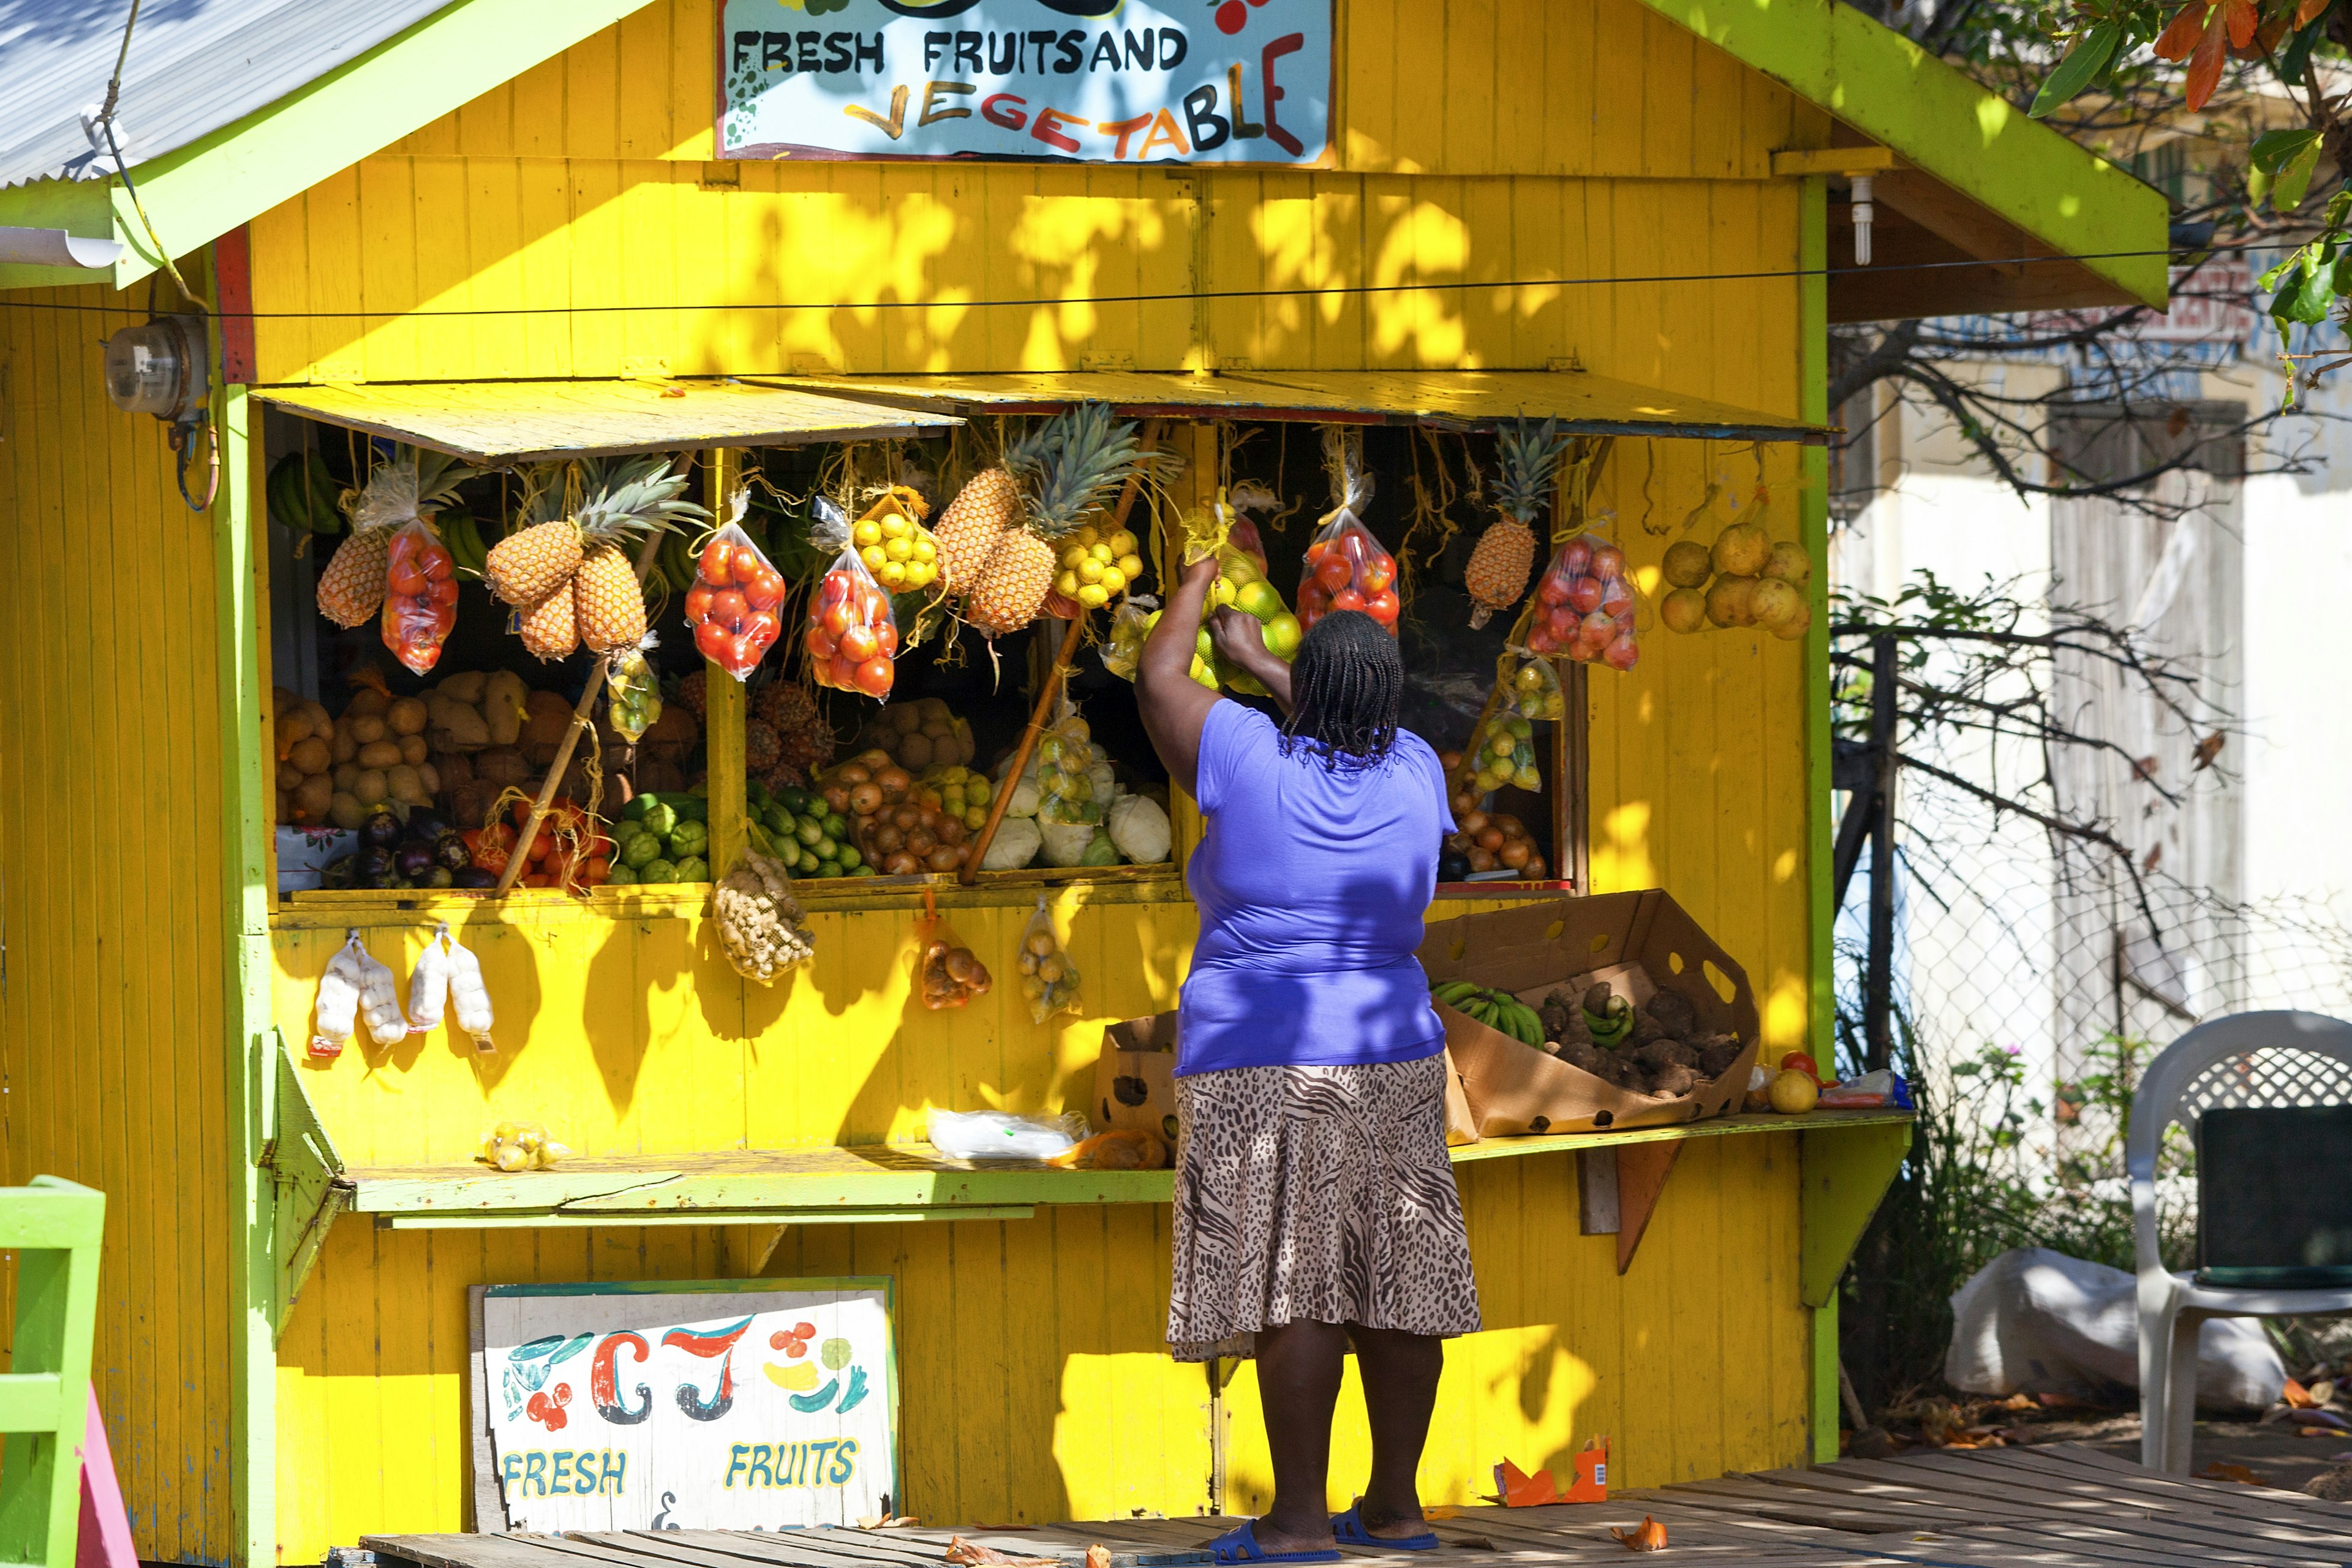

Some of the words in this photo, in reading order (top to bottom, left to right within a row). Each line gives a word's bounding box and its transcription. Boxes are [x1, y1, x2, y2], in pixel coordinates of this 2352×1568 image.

[733, 31, 884, 75] FRESH
[843, 32, 1305, 160] VEGETABLE
[502, 1450, 627, 1496] FRESH
[725, 1438, 859, 1488] FRUITS
